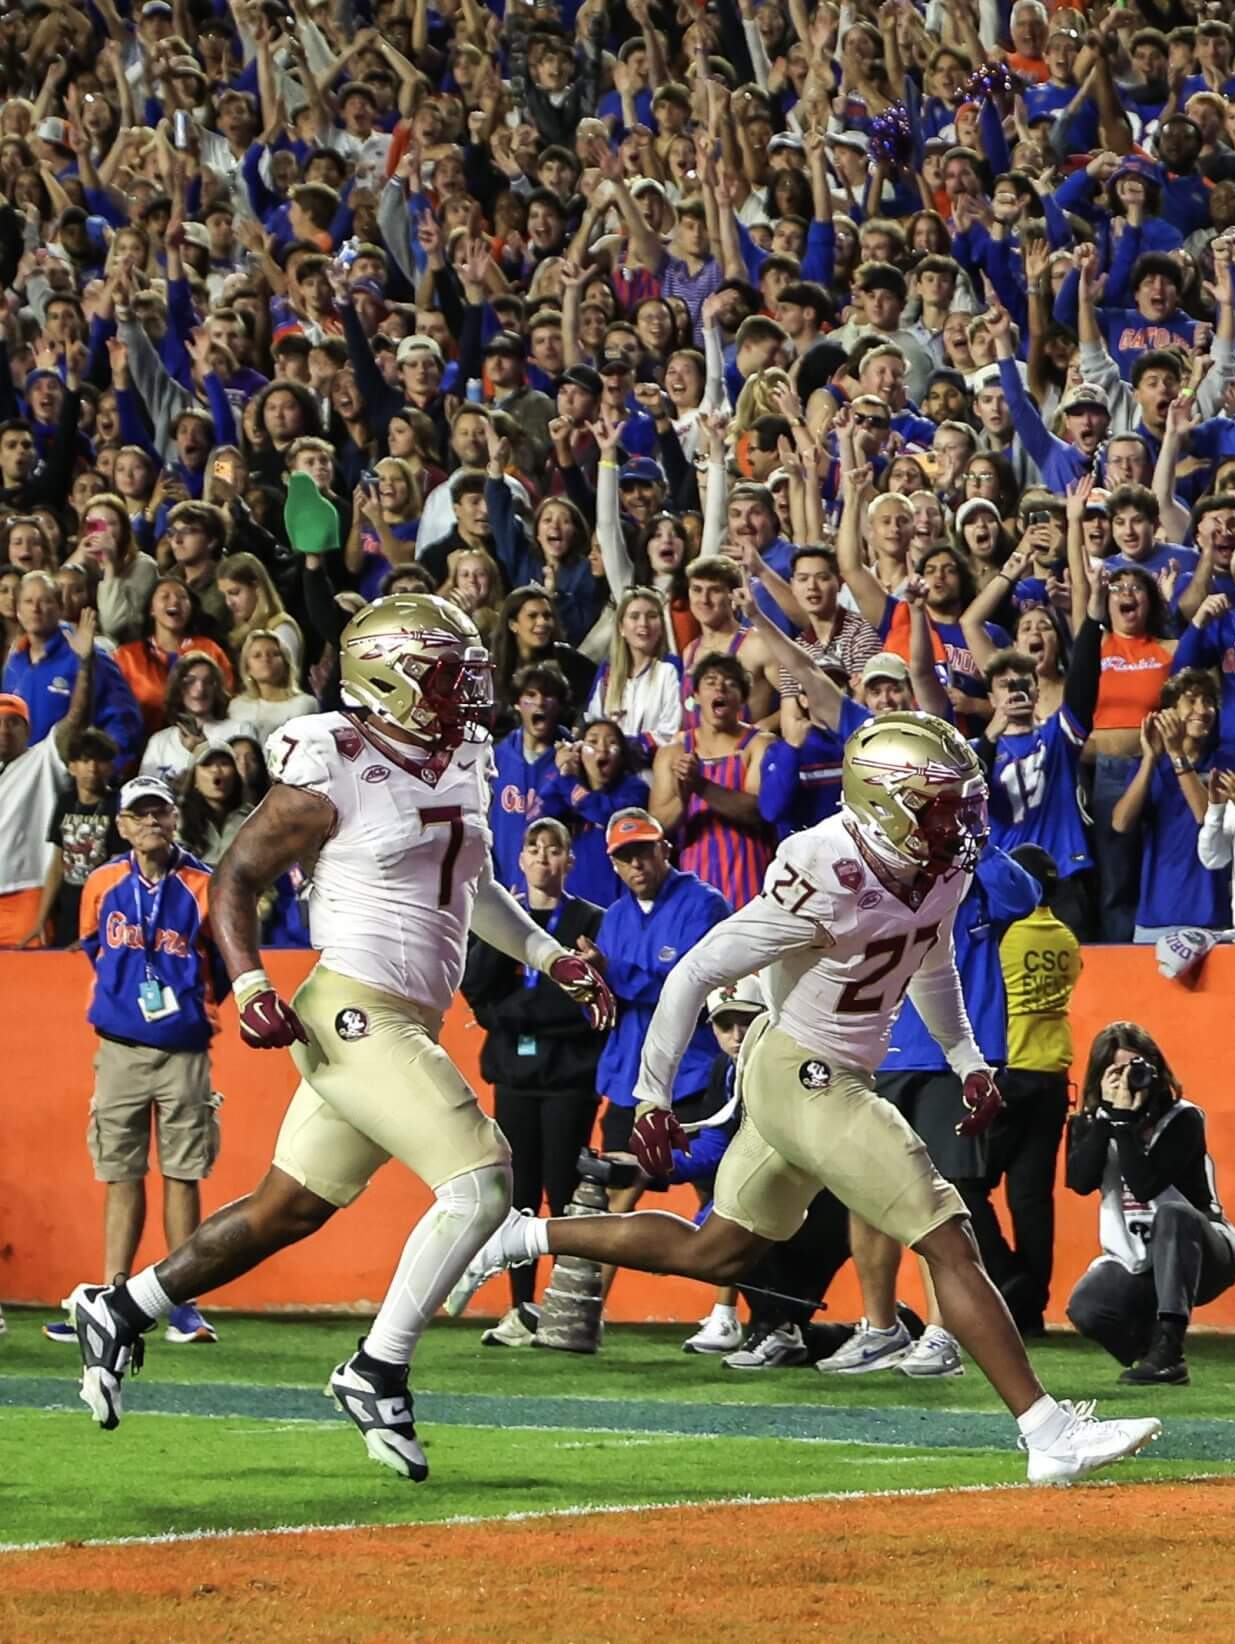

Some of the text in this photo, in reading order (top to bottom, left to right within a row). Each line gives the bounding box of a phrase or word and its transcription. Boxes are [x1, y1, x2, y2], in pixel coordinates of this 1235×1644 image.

[280, 735, 299, 774] 7
[418, 805, 465, 909] 7
[1024, 949, 1070, 973] CSC
